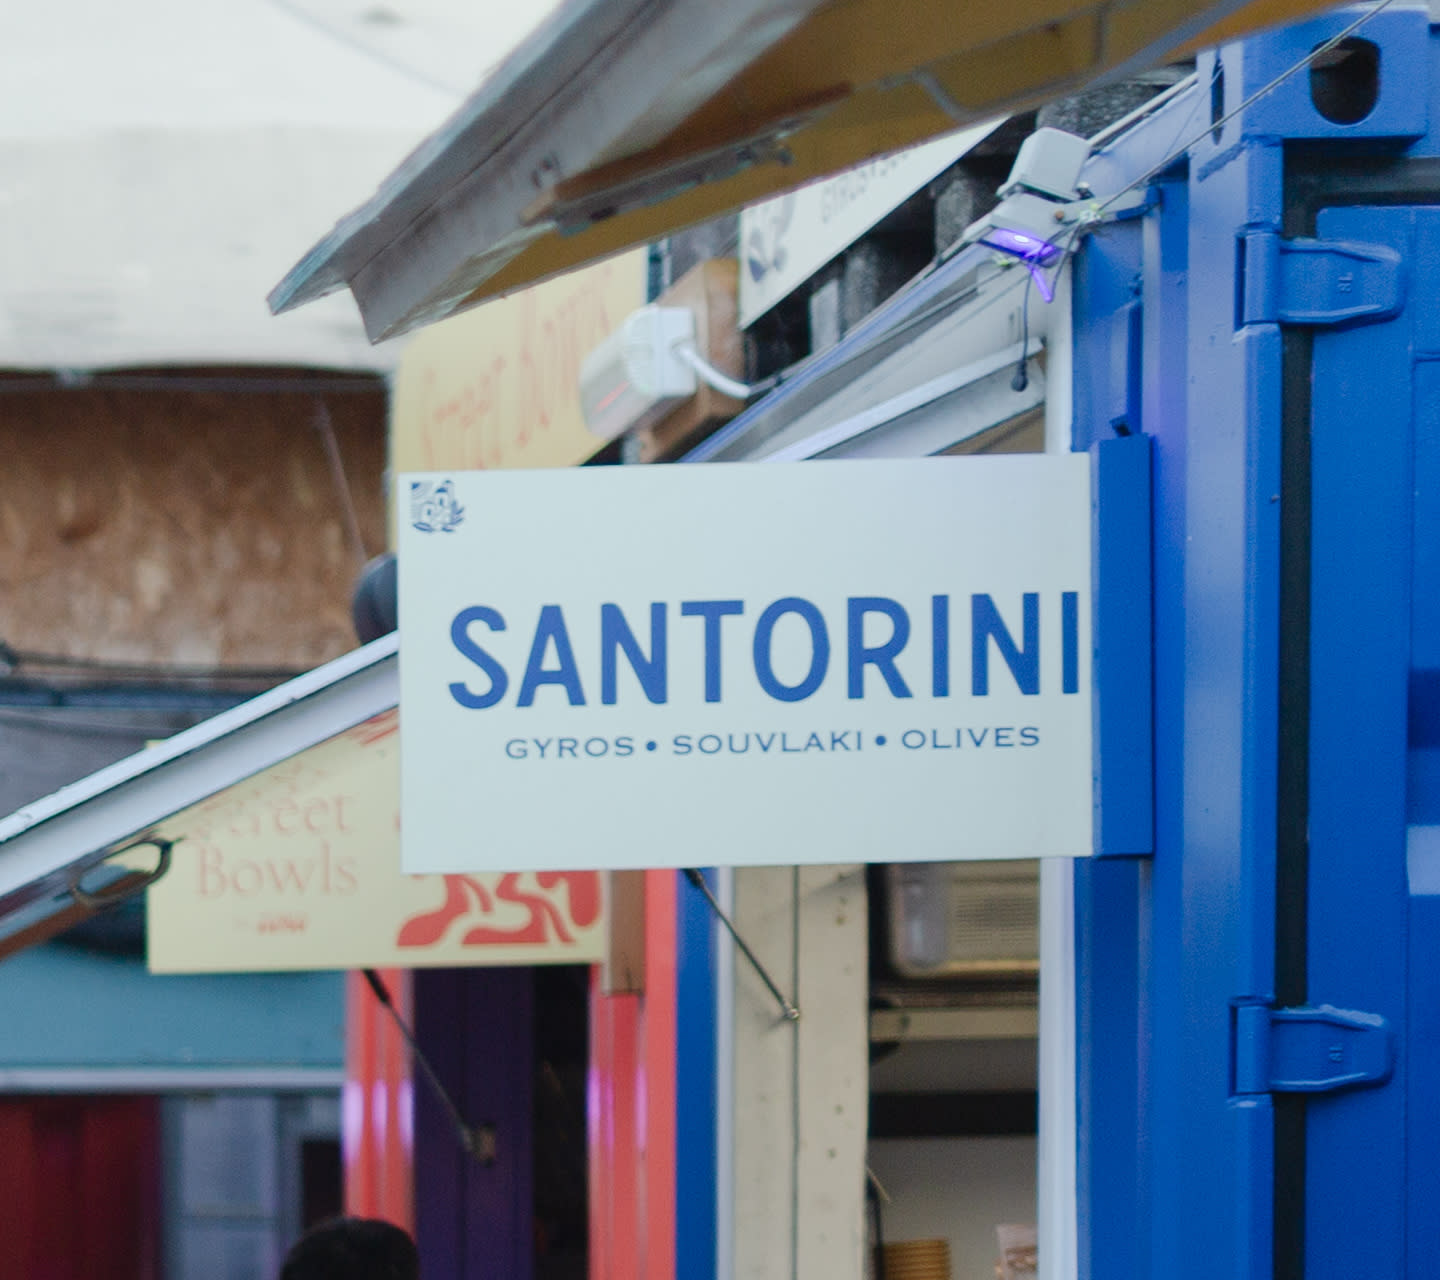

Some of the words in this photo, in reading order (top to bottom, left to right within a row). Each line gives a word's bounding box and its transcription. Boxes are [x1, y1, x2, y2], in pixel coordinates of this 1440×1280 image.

[448, 591, 1079, 709] SANTORINI
[505, 736, 635, 760] GYROS
[671, 731, 864, 755] SOUVLAKI
[901, 726, 1041, 750] OLIVES
[195, 840, 359, 900] Bowls
